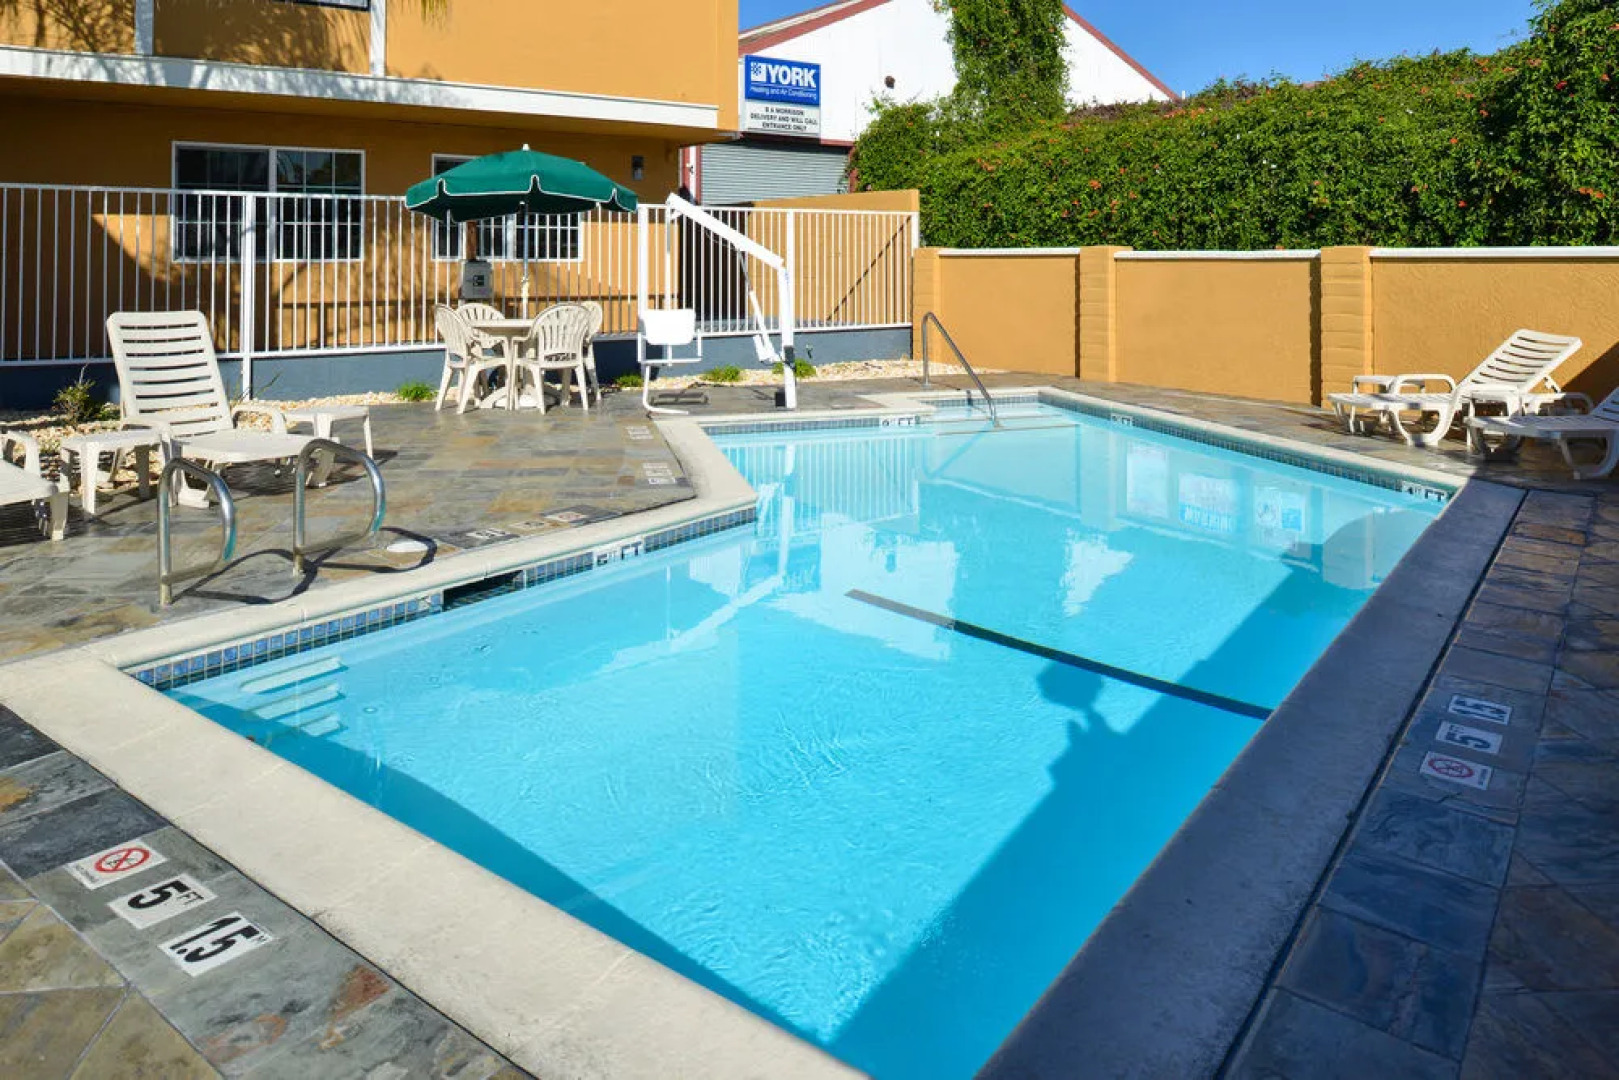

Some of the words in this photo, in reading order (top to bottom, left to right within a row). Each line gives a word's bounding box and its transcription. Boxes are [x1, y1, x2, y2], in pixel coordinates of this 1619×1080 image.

[768, 64, 816, 88] YORK
[750, 112, 778, 121] DELIVERY
[791, 116, 804, 124] WILL
[804, 117, 818, 125] CALL
[762, 121, 792, 130] ENTRANCE
[1445, 732, 1490, 748] 5
[127, 880, 191, 909] 5
[174, 890, 206, 907] FT
[170, 917, 260, 962] 1.5
